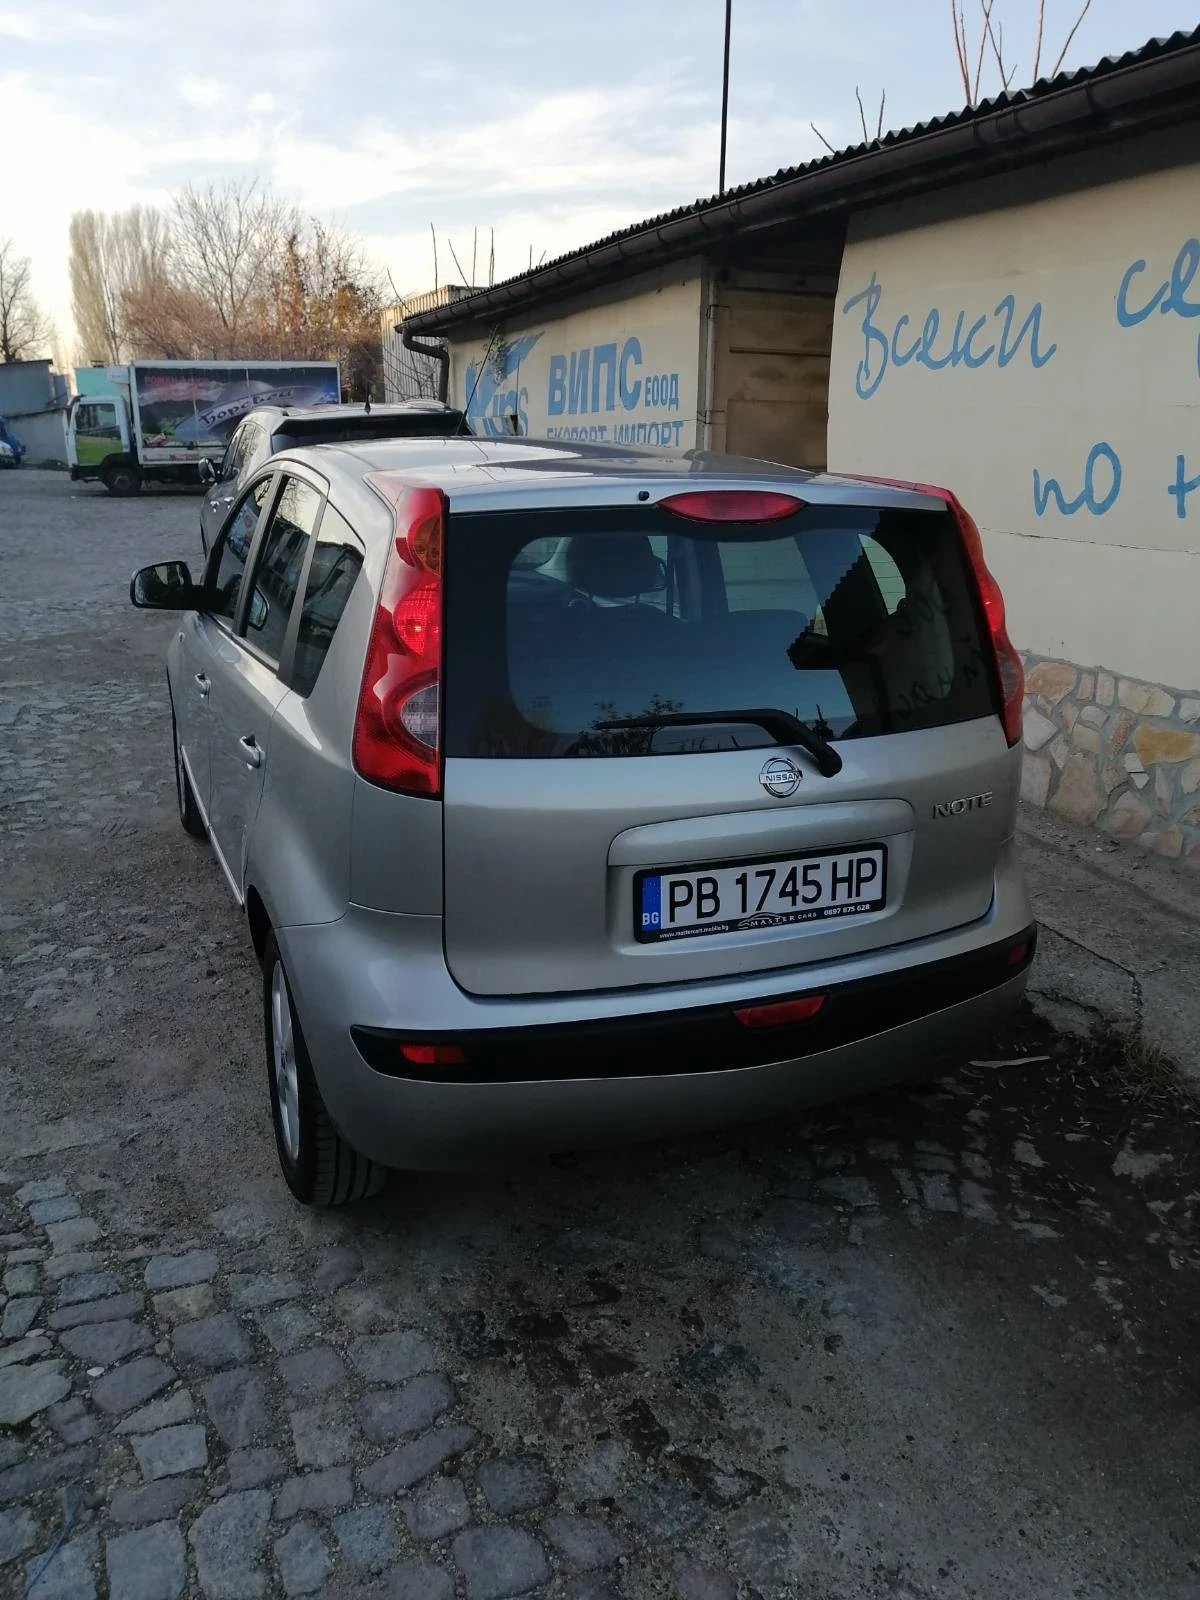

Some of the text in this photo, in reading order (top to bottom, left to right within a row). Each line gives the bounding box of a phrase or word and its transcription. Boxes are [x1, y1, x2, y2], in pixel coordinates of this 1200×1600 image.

[842, 271, 1057, 400] Всеки
[548, 336, 679, 416] ВИПС ЕООД
[765, 771, 802, 783] NISSAN
[932, 791, 993, 820] NOTE
[668, 856, 878, 923] PB 1745 HP
[642, 912, 660, 926] BG
[750, 915, 795, 927] MASTER
[824, 907, 841, 916] 0897
